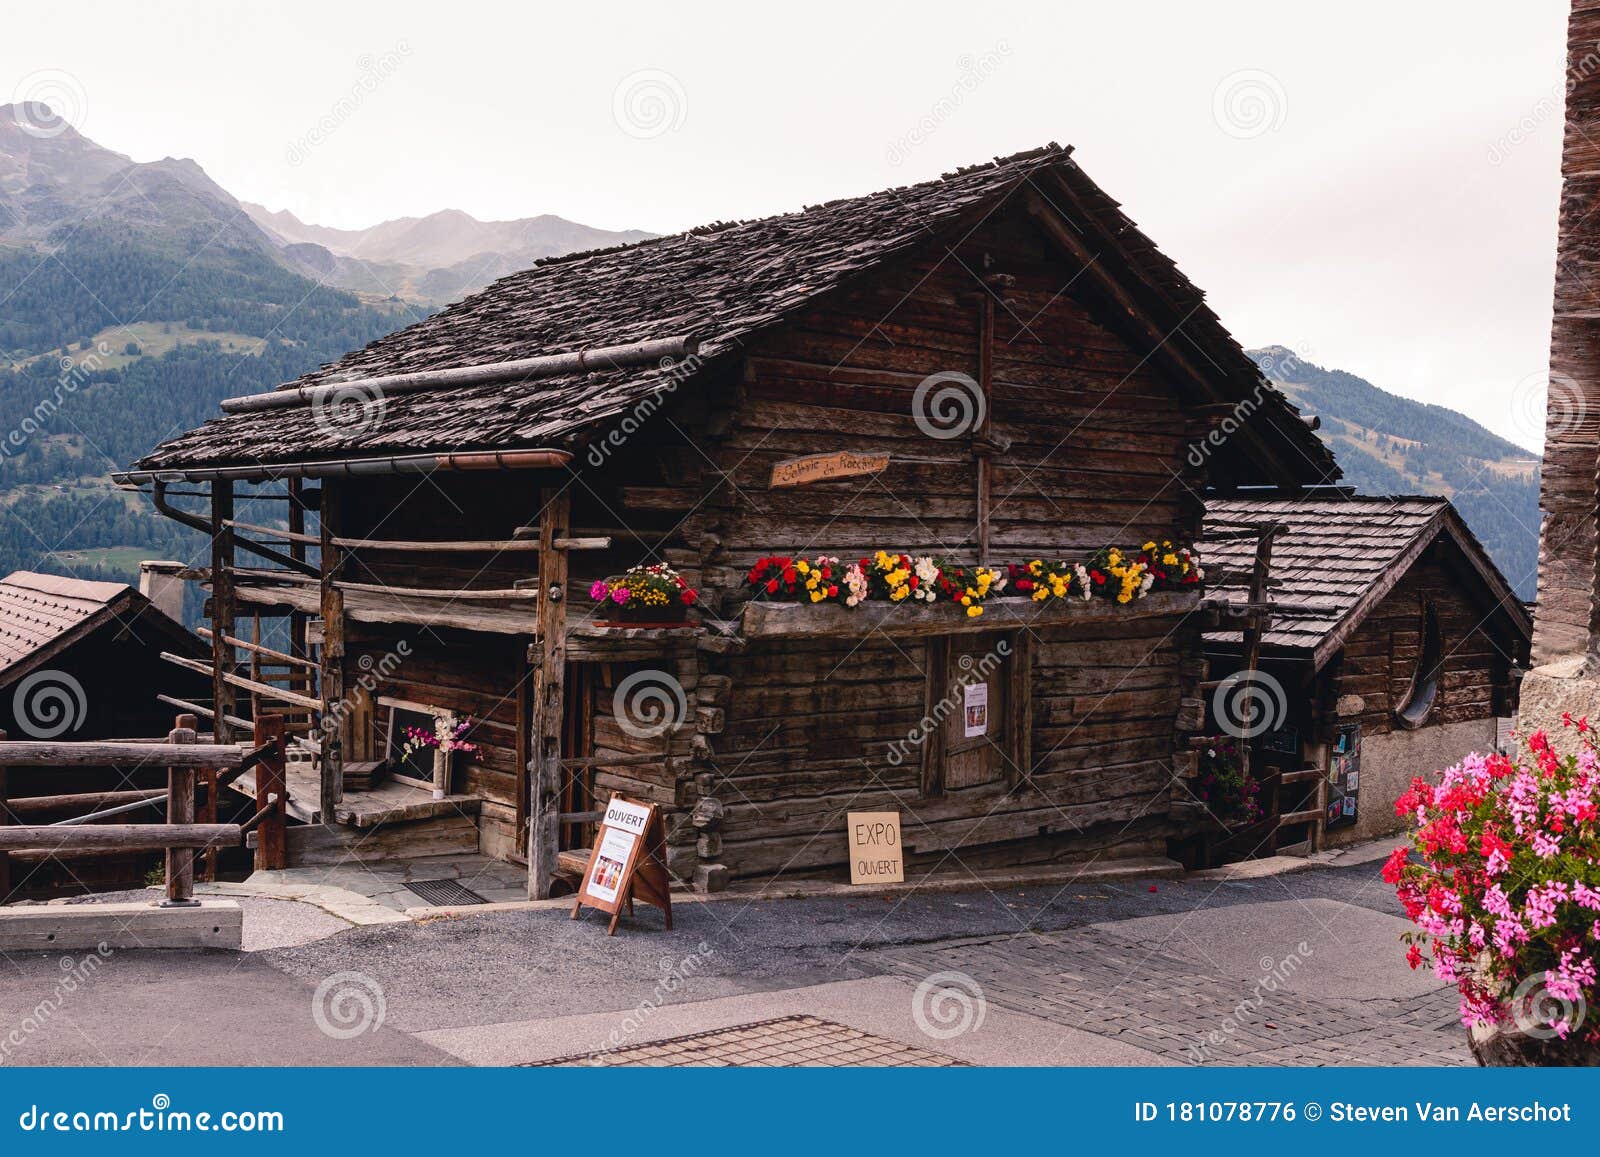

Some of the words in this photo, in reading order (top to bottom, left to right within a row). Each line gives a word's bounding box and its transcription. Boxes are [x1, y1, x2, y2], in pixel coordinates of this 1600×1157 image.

[608, 809, 645, 828] OUVERT
[855, 822, 896, 846] EXPO
[858, 860, 899, 876] OUVERT
